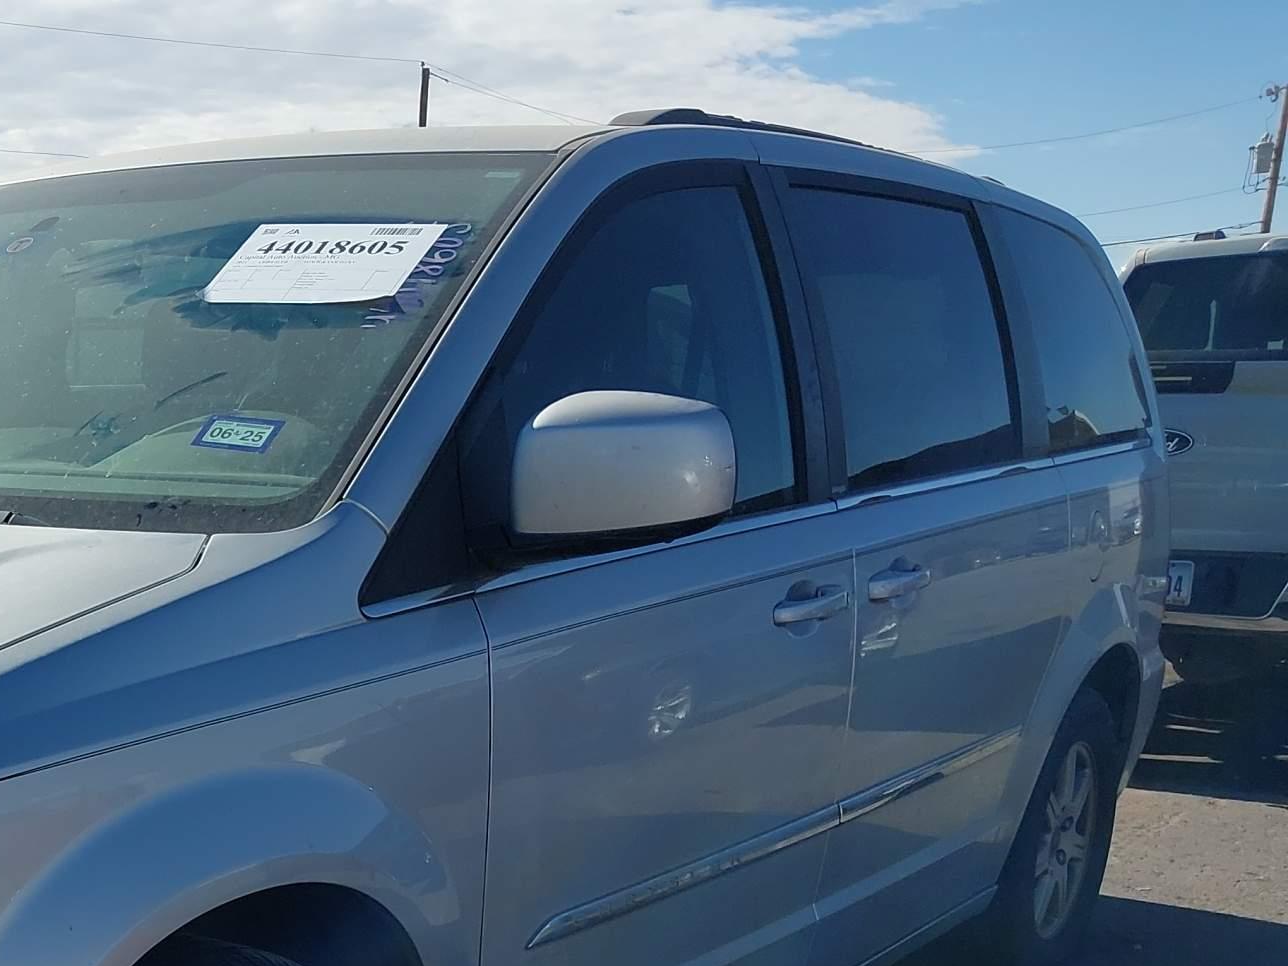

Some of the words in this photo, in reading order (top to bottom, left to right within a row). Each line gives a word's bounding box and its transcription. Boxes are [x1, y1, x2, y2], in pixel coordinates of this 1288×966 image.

[257, 240, 409, 255] 44018605
[209, 427, 234, 439] 06
[239, 430, 267, 442] 25
